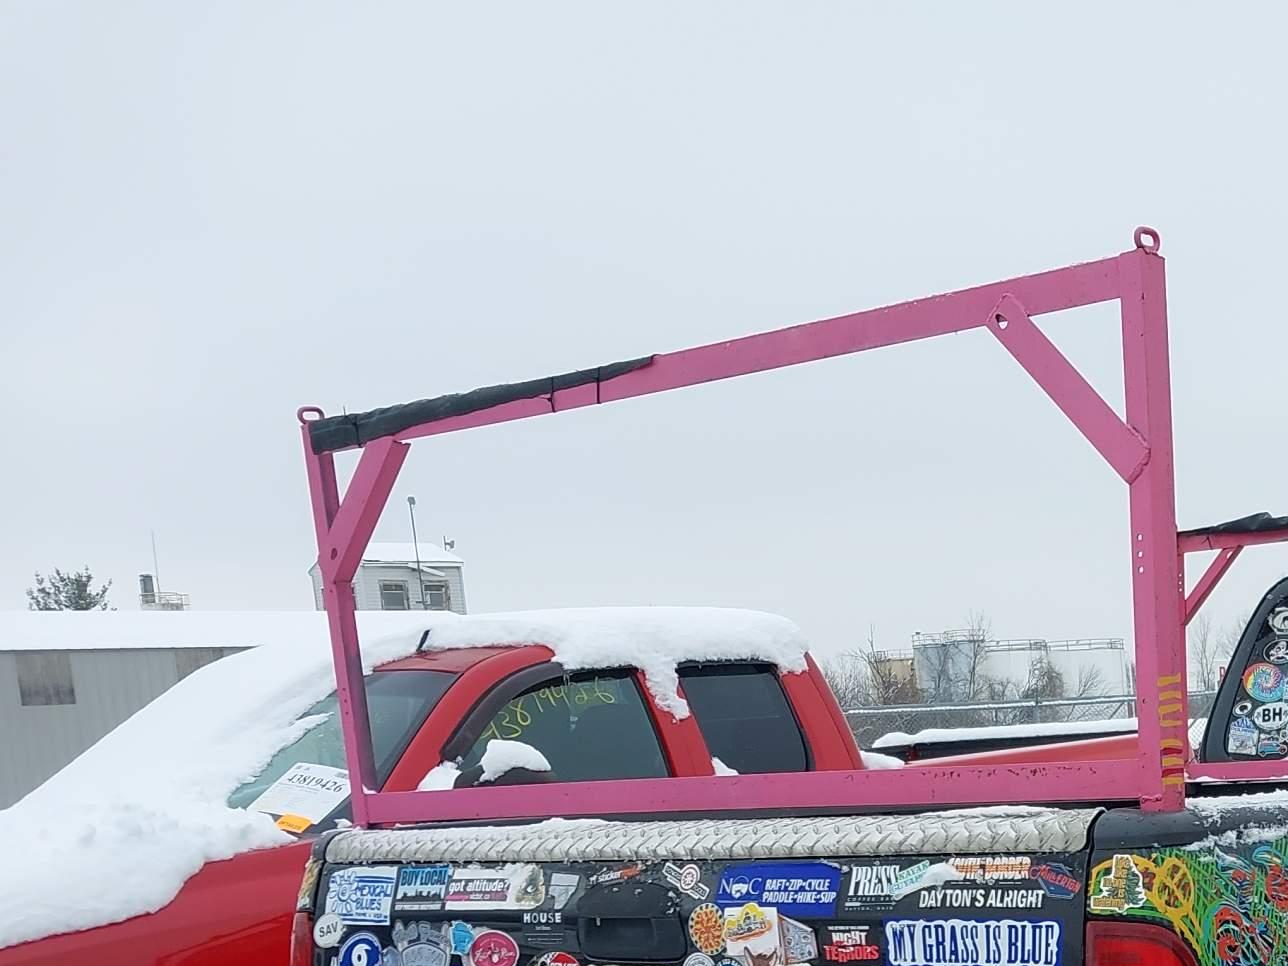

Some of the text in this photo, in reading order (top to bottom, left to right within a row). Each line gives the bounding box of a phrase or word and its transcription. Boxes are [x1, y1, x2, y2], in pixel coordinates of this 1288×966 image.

[1261, 707, 1283, 722] BH
[401, 868, 447, 886] BUY LOCAL
[448, 879, 509, 892] got altitude?
[918, 889, 1045, 909] DAYTON'S ALRIGHT
[523, 912, 562, 924] HOUSE
[318, 922, 339, 939] SAV
[831, 931, 867, 946] NIGHT
[892, 924, 1055, 965] MY GRASS IS BLUE
